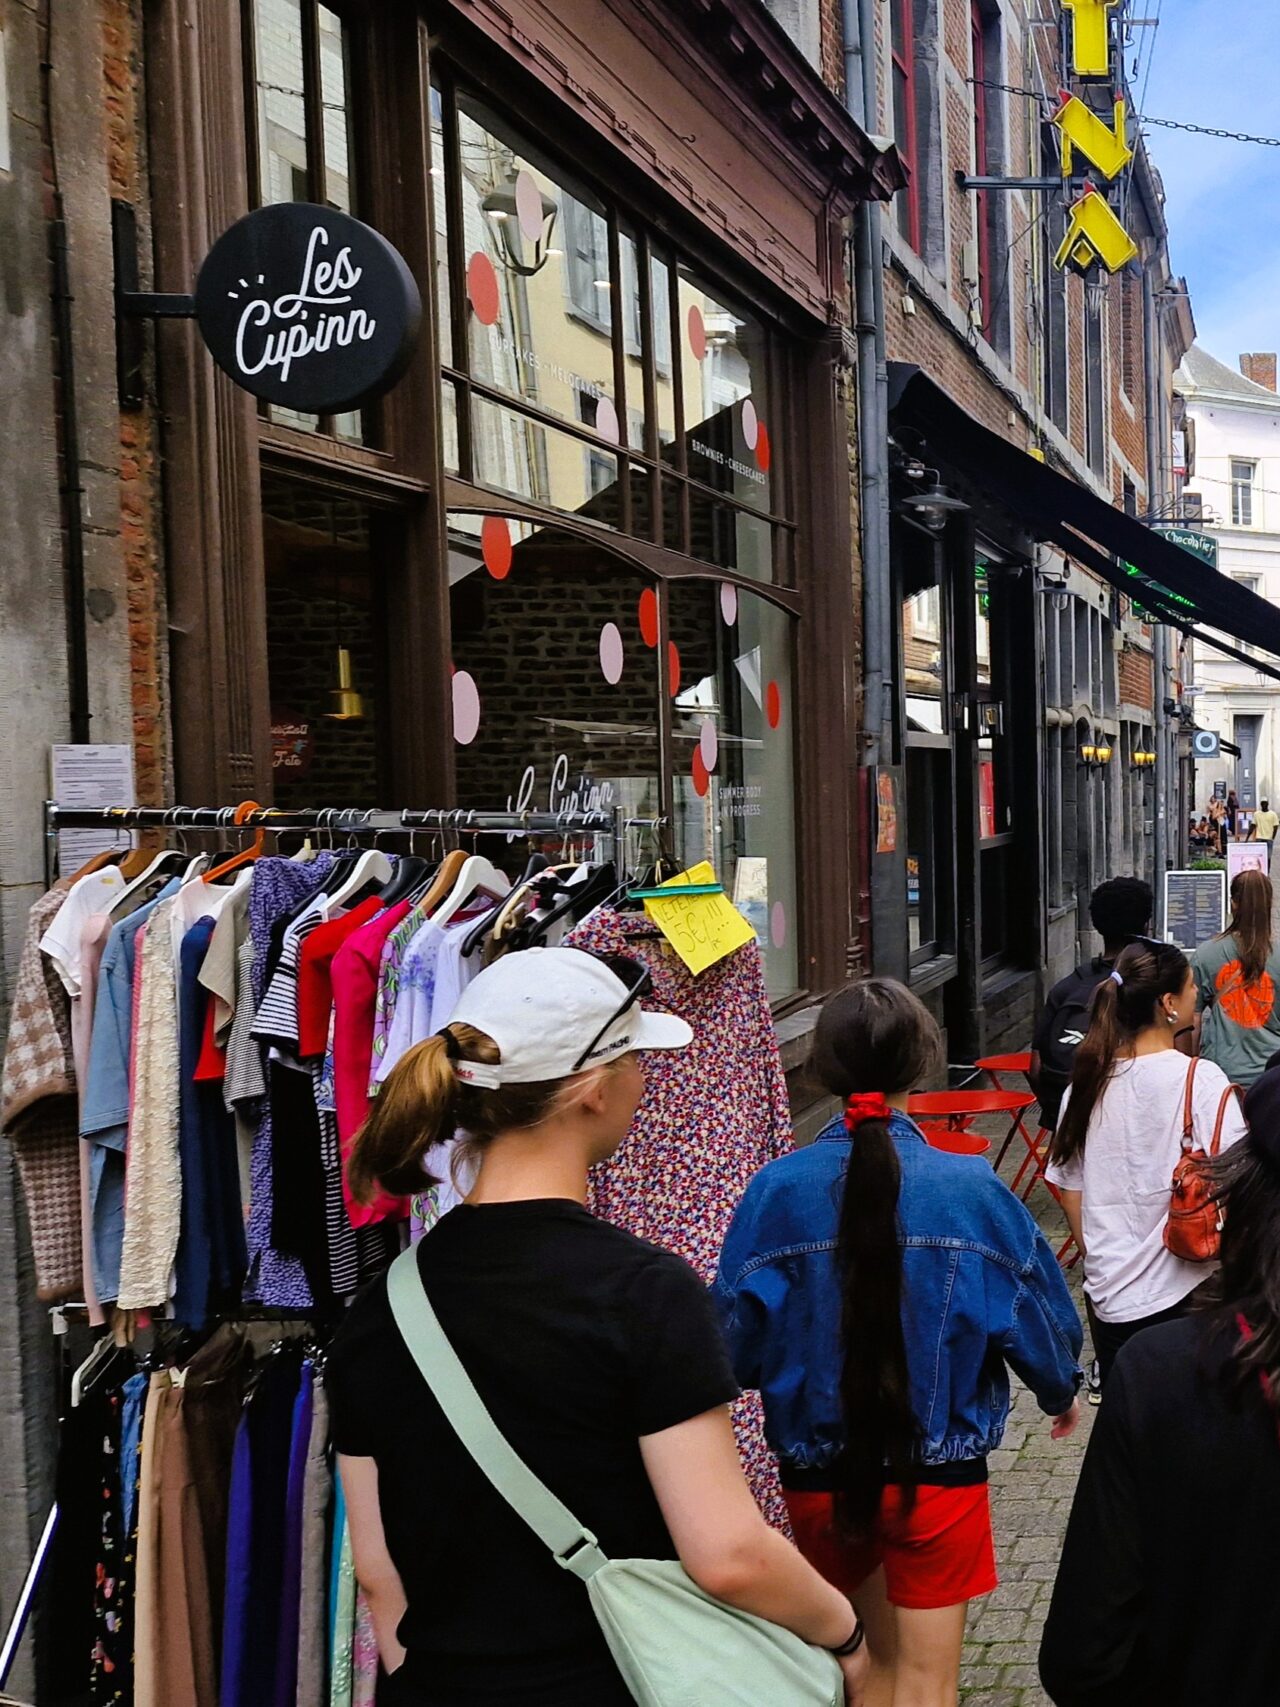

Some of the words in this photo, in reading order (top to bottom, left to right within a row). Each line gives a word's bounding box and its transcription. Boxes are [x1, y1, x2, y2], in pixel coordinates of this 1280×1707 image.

[273, 226, 362, 319] Les
[692, 439, 724, 465] BROWNIES
[728, 457, 766, 485] CHEESECAKES
[1164, 531, 1216, 558] Chocolatier
